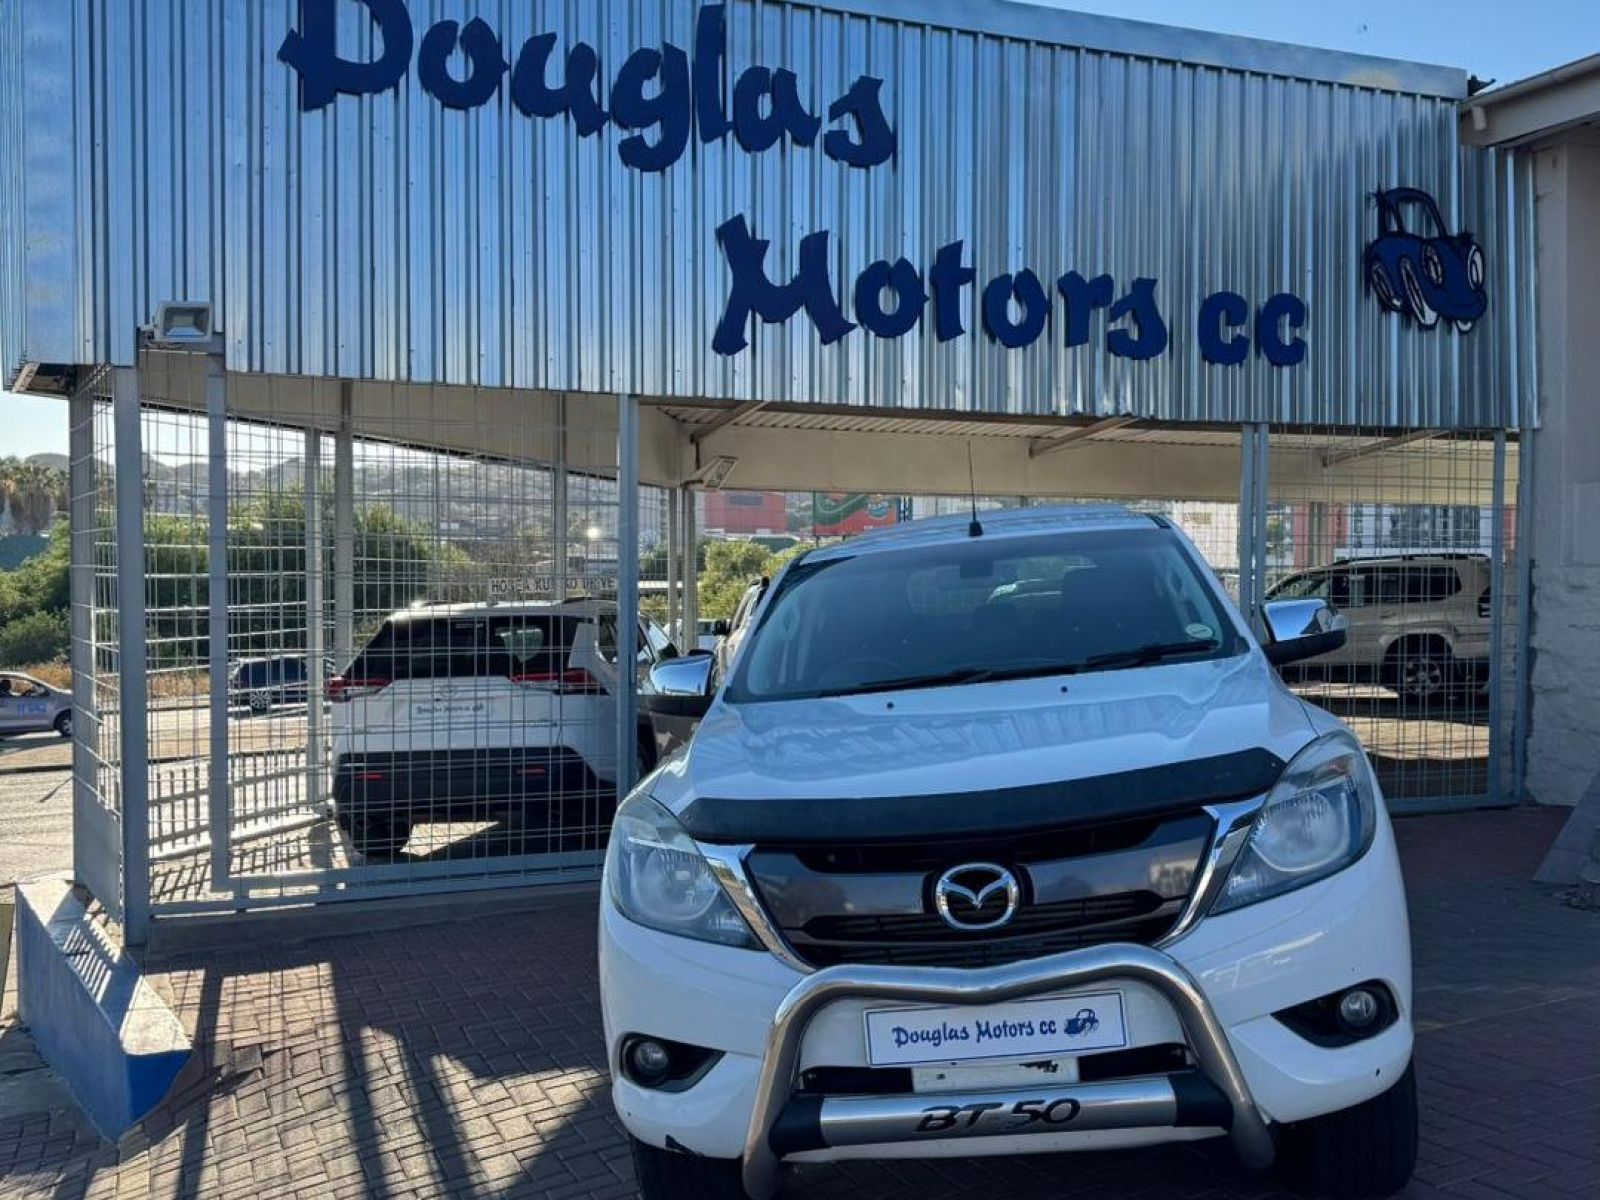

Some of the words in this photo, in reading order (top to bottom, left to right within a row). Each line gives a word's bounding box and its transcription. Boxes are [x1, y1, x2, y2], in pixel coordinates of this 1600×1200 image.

[277, 0, 897, 171] Douglas
[712, 213, 1168, 360] Motors
[1201, 291, 1306, 367] cc
[891, 1022, 970, 1047] Douglas
[976, 1019, 1035, 1043] Motors
[1039, 1019, 1057, 1035] cc
[915, 1102, 1004, 1133] BT
[1005, 1098, 1081, 1130] 50
